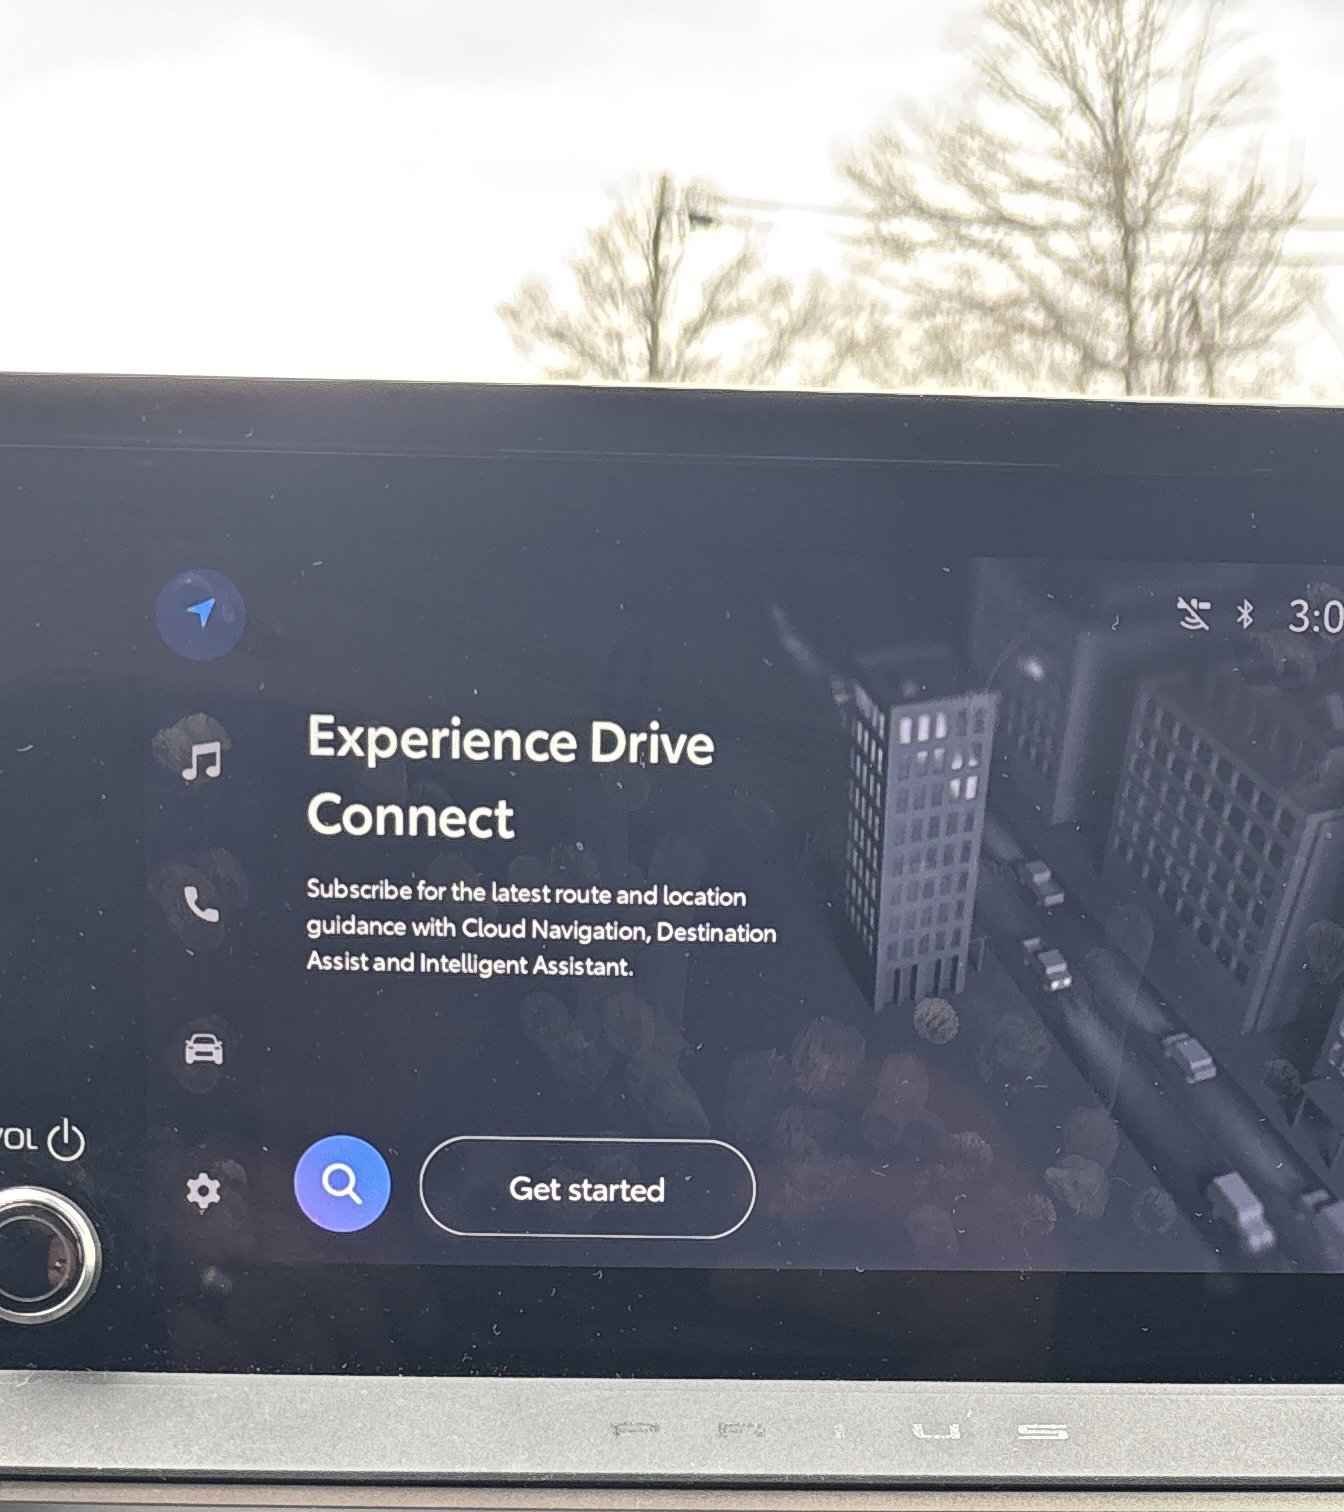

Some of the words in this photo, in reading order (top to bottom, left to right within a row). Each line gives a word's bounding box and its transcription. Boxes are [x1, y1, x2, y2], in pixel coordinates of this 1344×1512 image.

[307, 713, 578, 769] Experience
[591, 719, 715, 766] Drive
[306, 791, 516, 840] Connect
[306, 876, 413, 902] Subscribe
[416, 879, 448, 902] for
[451, 879, 486, 903] the
[491, 880, 552, 904] latest
[555, 886, 612, 905] route
[616, 883, 658, 906] and
[663, 883, 747, 907] location
[306, 914, 407, 941] guidance
[411, 915, 457, 938] with
[461, 916, 527, 939] Cloud
[531, 918, 652, 944] Navigation,
[656, 921, 777, 945] Destination
[306, 950, 370, 972] Assist
[372, 951, 415, 973] and
[420, 952, 529, 978] Intelligent
[532, 954, 634, 977] Assistant.
[509, 1175, 562, 1203] Get
[567, 1176, 666, 1204] started
